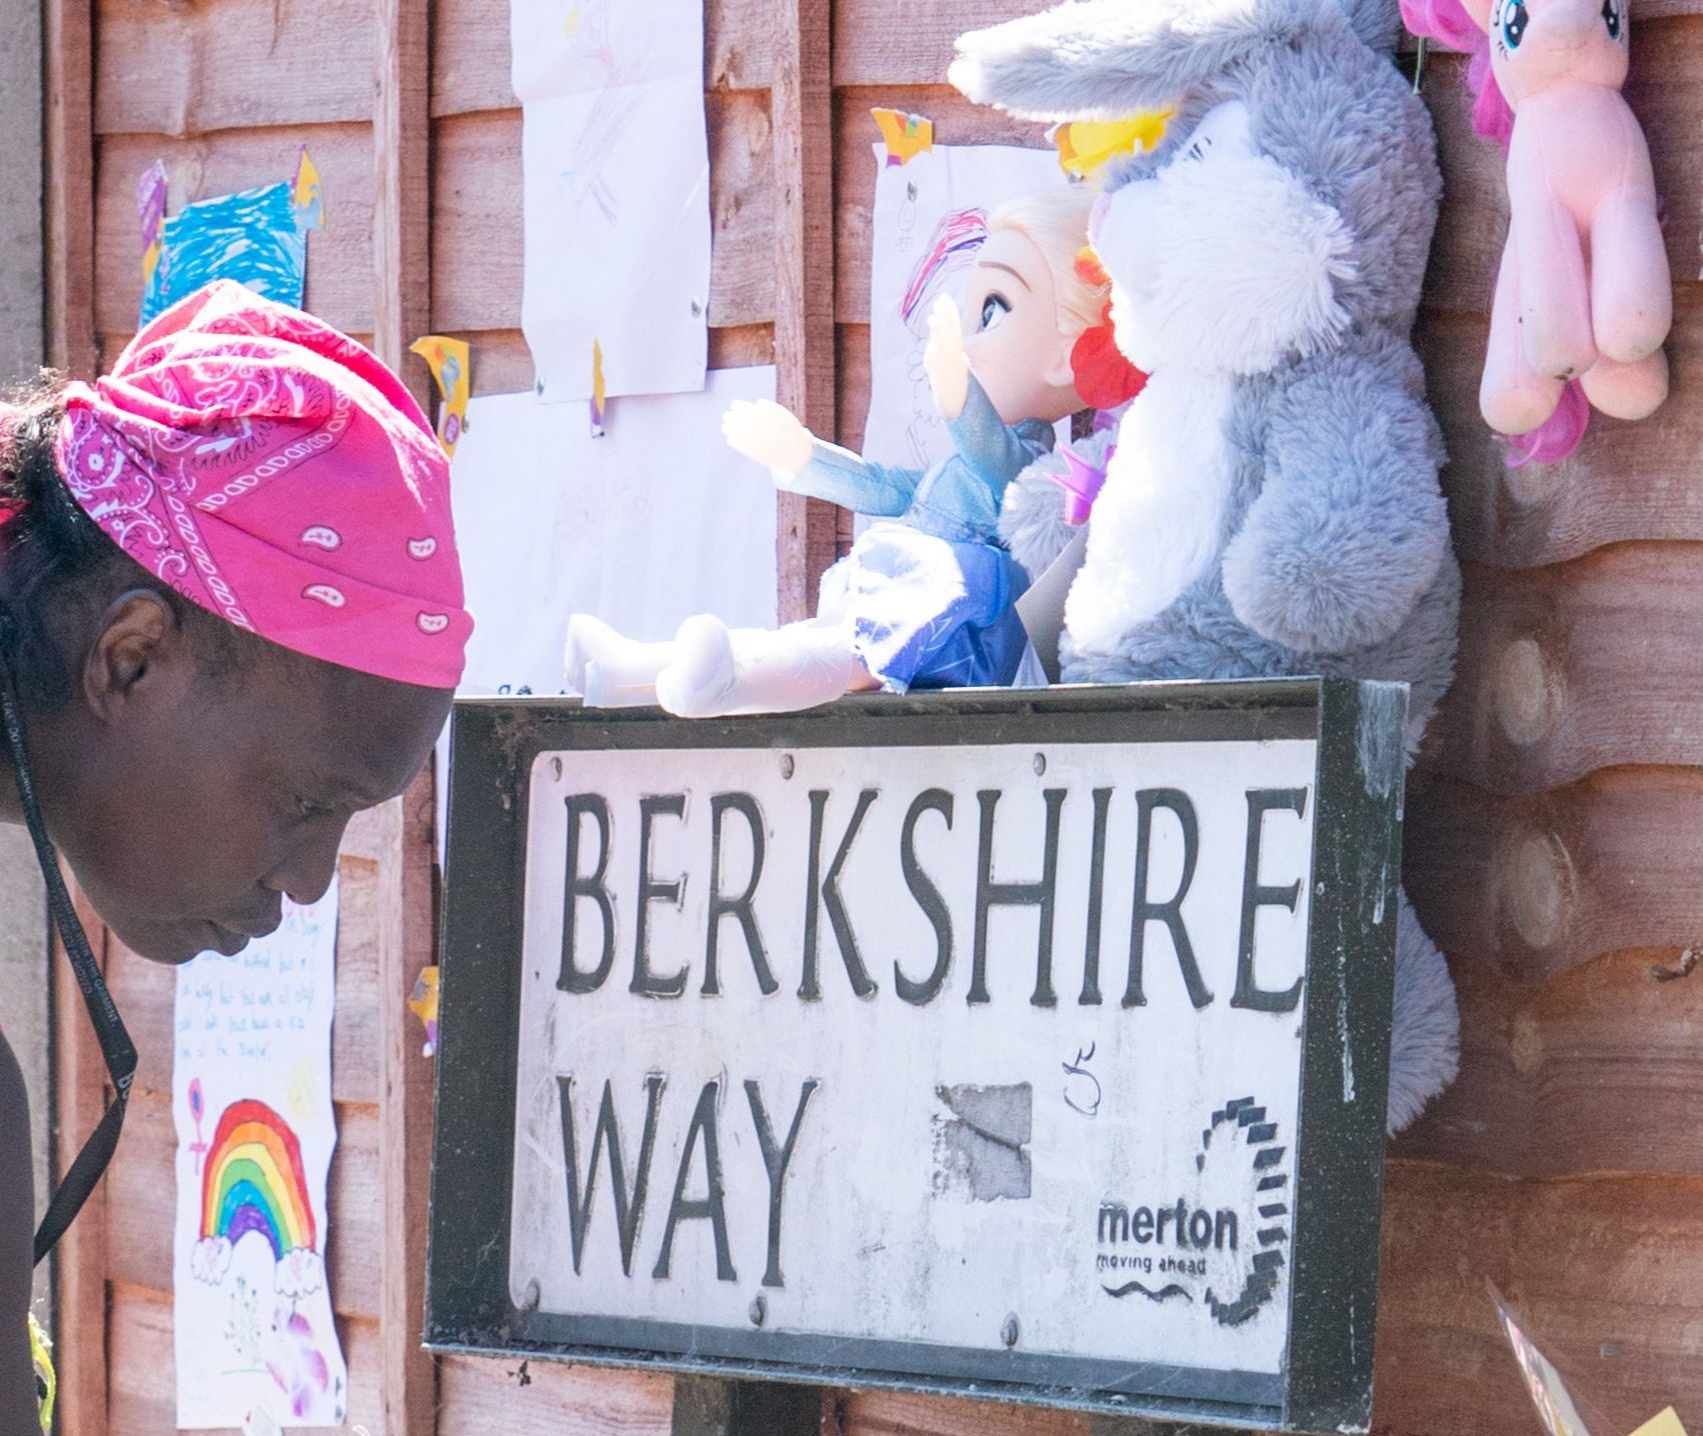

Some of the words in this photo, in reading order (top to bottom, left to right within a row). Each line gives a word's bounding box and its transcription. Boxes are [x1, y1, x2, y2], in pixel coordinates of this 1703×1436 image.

[555, 786, 1309, 1013] BERKSHIRE
[556, 1073, 822, 1288] WAY
[1098, 1198, 1238, 1250] merton
[1097, 1254, 1152, 1274] moving
[1159, 1255, 1206, 1275] ahead
